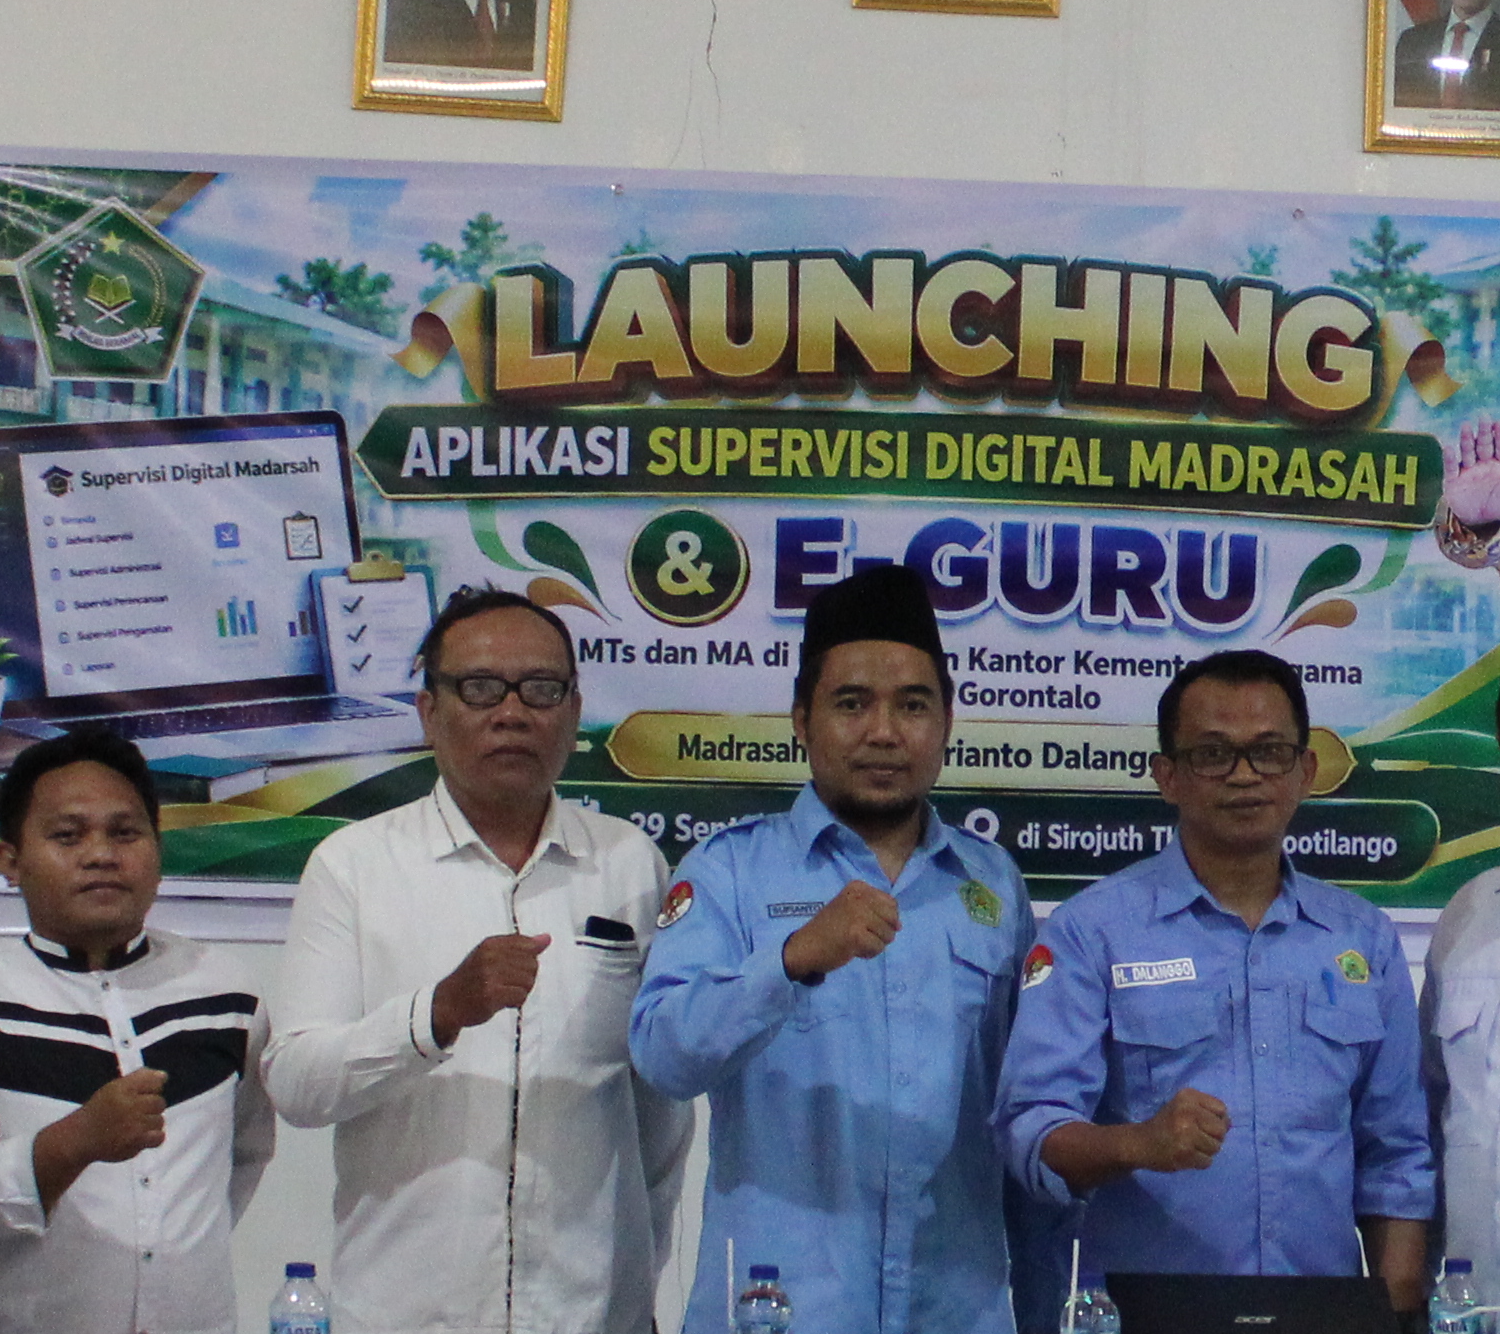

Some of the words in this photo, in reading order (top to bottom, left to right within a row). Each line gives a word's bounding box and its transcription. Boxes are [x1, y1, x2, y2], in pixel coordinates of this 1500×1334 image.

[494, 256, 1376, 413] LAUNCHING
[81, 465, 167, 490] Supervisi
[171, 461, 231, 484] Digital
[234, 457, 321, 477] Madarsah
[399, 425, 630, 478] APLIKASI
[646, 427, 909, 480] SUPERVISI
[925, 431, 1114, 487] DIGITAL
[1128, 439, 1419, 506] MADRASAH
[656, 530, 714, 596] &
[774, 516, 1259, 626] E-GURU
[578, 637, 636, 664] MTs
[644, 638, 698, 666] dan
[706, 640, 755, 667] MA
[762, 641, 790, 668] di
[968, 646, 1066, 675] Kantor
[957, 681, 1102, 710] Gorontalo
[677, 733, 808, 764] Madrasah
[943, 738, 1033, 768] rianto
[1016, 821, 1041, 850] di
[1046, 823, 1144, 857] Sirojuth
[1282, 828, 1398, 863] ootilango
